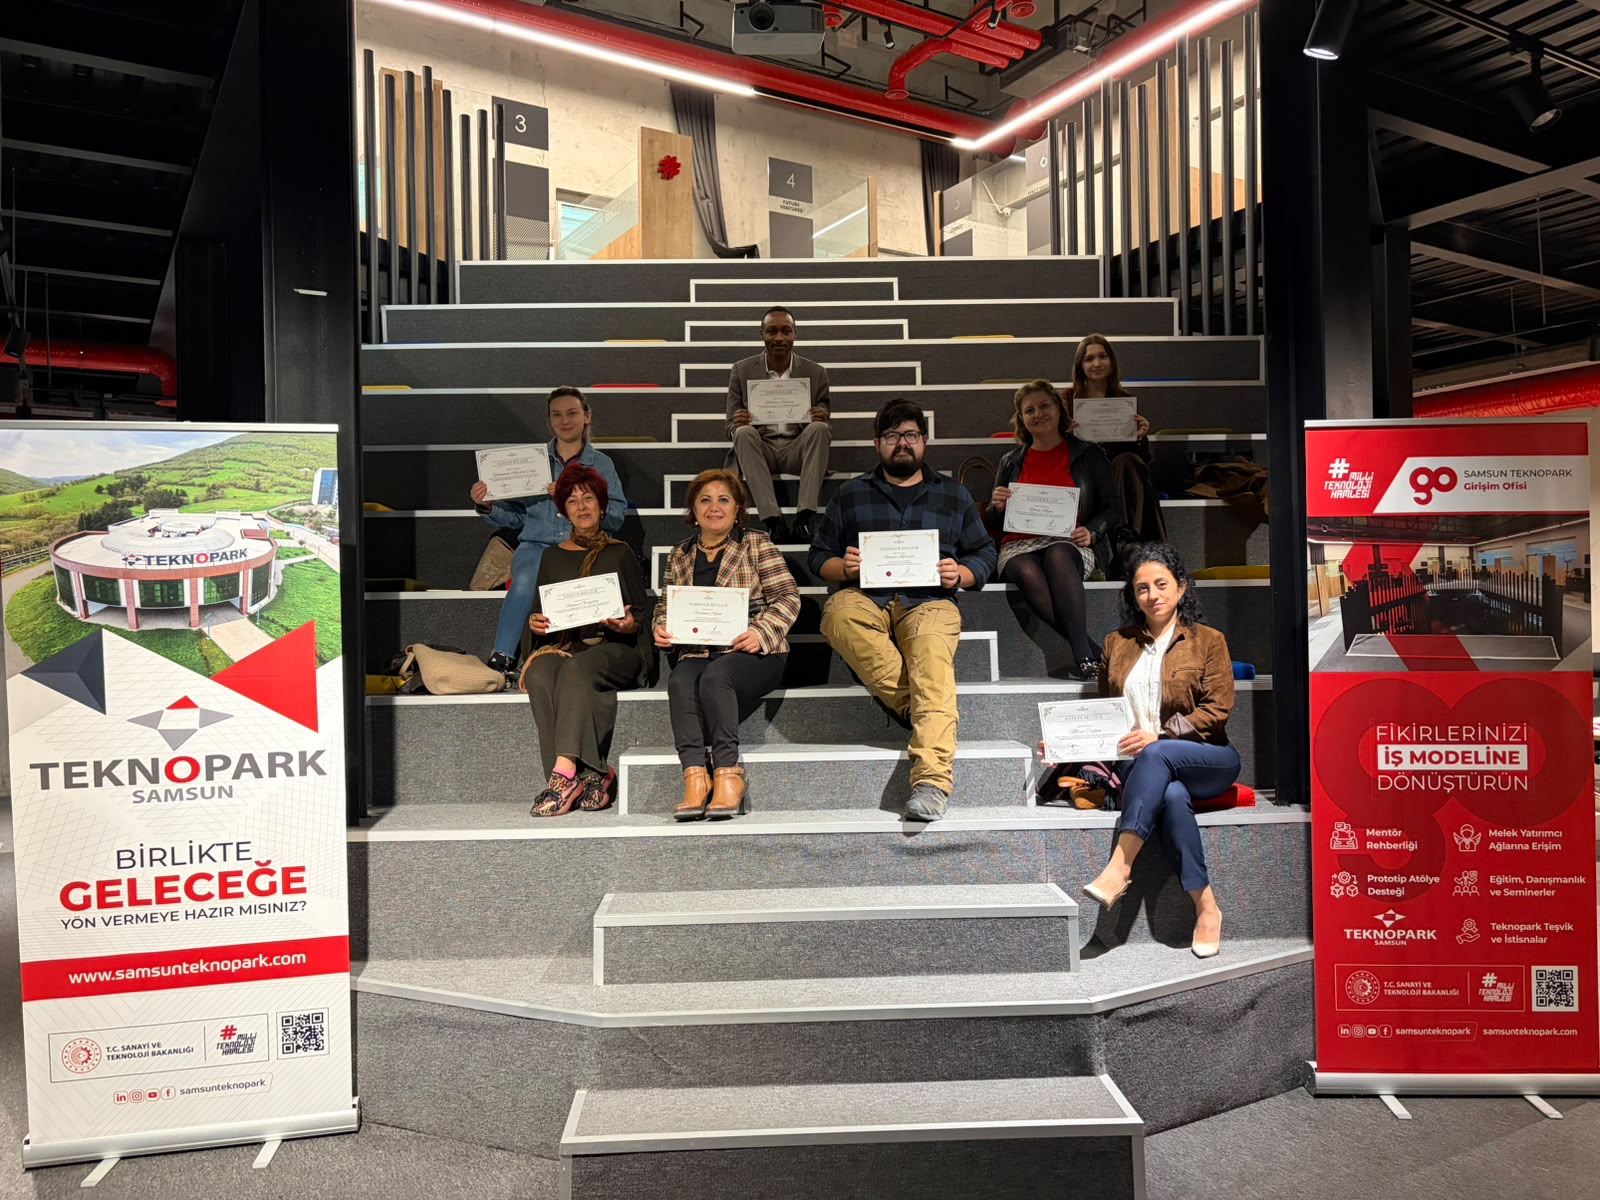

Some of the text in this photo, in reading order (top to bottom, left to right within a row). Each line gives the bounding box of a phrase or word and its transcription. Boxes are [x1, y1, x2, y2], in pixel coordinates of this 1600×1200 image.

[514, 114, 527, 133] 3
[786, 173, 796, 188] 4
[779, 204, 804, 213] VENTURES
[1463, 469, 1572, 478] SAMSUN TEKNOPARK
[1409, 467, 1458, 506] go
[1463, 481, 1527, 492] Girişim Ofisi
[143, 548, 248, 566] TEKNOPARK
[1376, 722, 1527, 742] FİKİRLERİNİZİ
[1384, 746, 1520, 767] İŞ MODELİNE
[29, 750, 327, 790] TEKNOPARK
[1377, 772, 1528, 793] DÖNÜŞTÜRÜN
[132, 785, 233, 803] SAMSUN
[1366, 829, 1402, 837] Mentör
[1489, 829, 1562, 837] Melek Yatırımcı
[1367, 841, 1418, 851] Rehberliği
[1489, 842, 1561, 852] Ağlarına Erişim
[116, 840, 253, 869] BİRLİKTE
[1367, 874, 1440, 884] Prototip Atölye
[1489, 875, 1586, 885] Eğitim, Danışmanlık
[60, 860, 307, 911] GELECEĞE
[1368, 887, 1405, 897] Desteği
[1503, 888, 1556, 896] Seminerler
[61, 900, 307, 930] YÖN VERMEYE HAZIR MISINIZ?
[1490, 922, 1574, 933] Teknopark Teşvik
[1343, 929, 1438, 940] TEKNOPARK
[1504, 934, 1548, 943] İstisnalar
[68, 953, 307, 984] www.samsunteknopark.com
[1396, 980, 1421, 988] SANAYİ
[1383, 988, 1459, 996] TEKNOLOJİ BAKANLIĞI
[1395, 1027, 1471, 1037] samsunteknopark
[1483, 1027, 1578, 1037] samsunteknopark.com
[121, 1042, 150, 1051] SANAYİ
[106, 1046, 194, 1061] TEKNOLOJİ BAKANLIĞI
[179, 1079, 266, 1096] samsunteknopark
